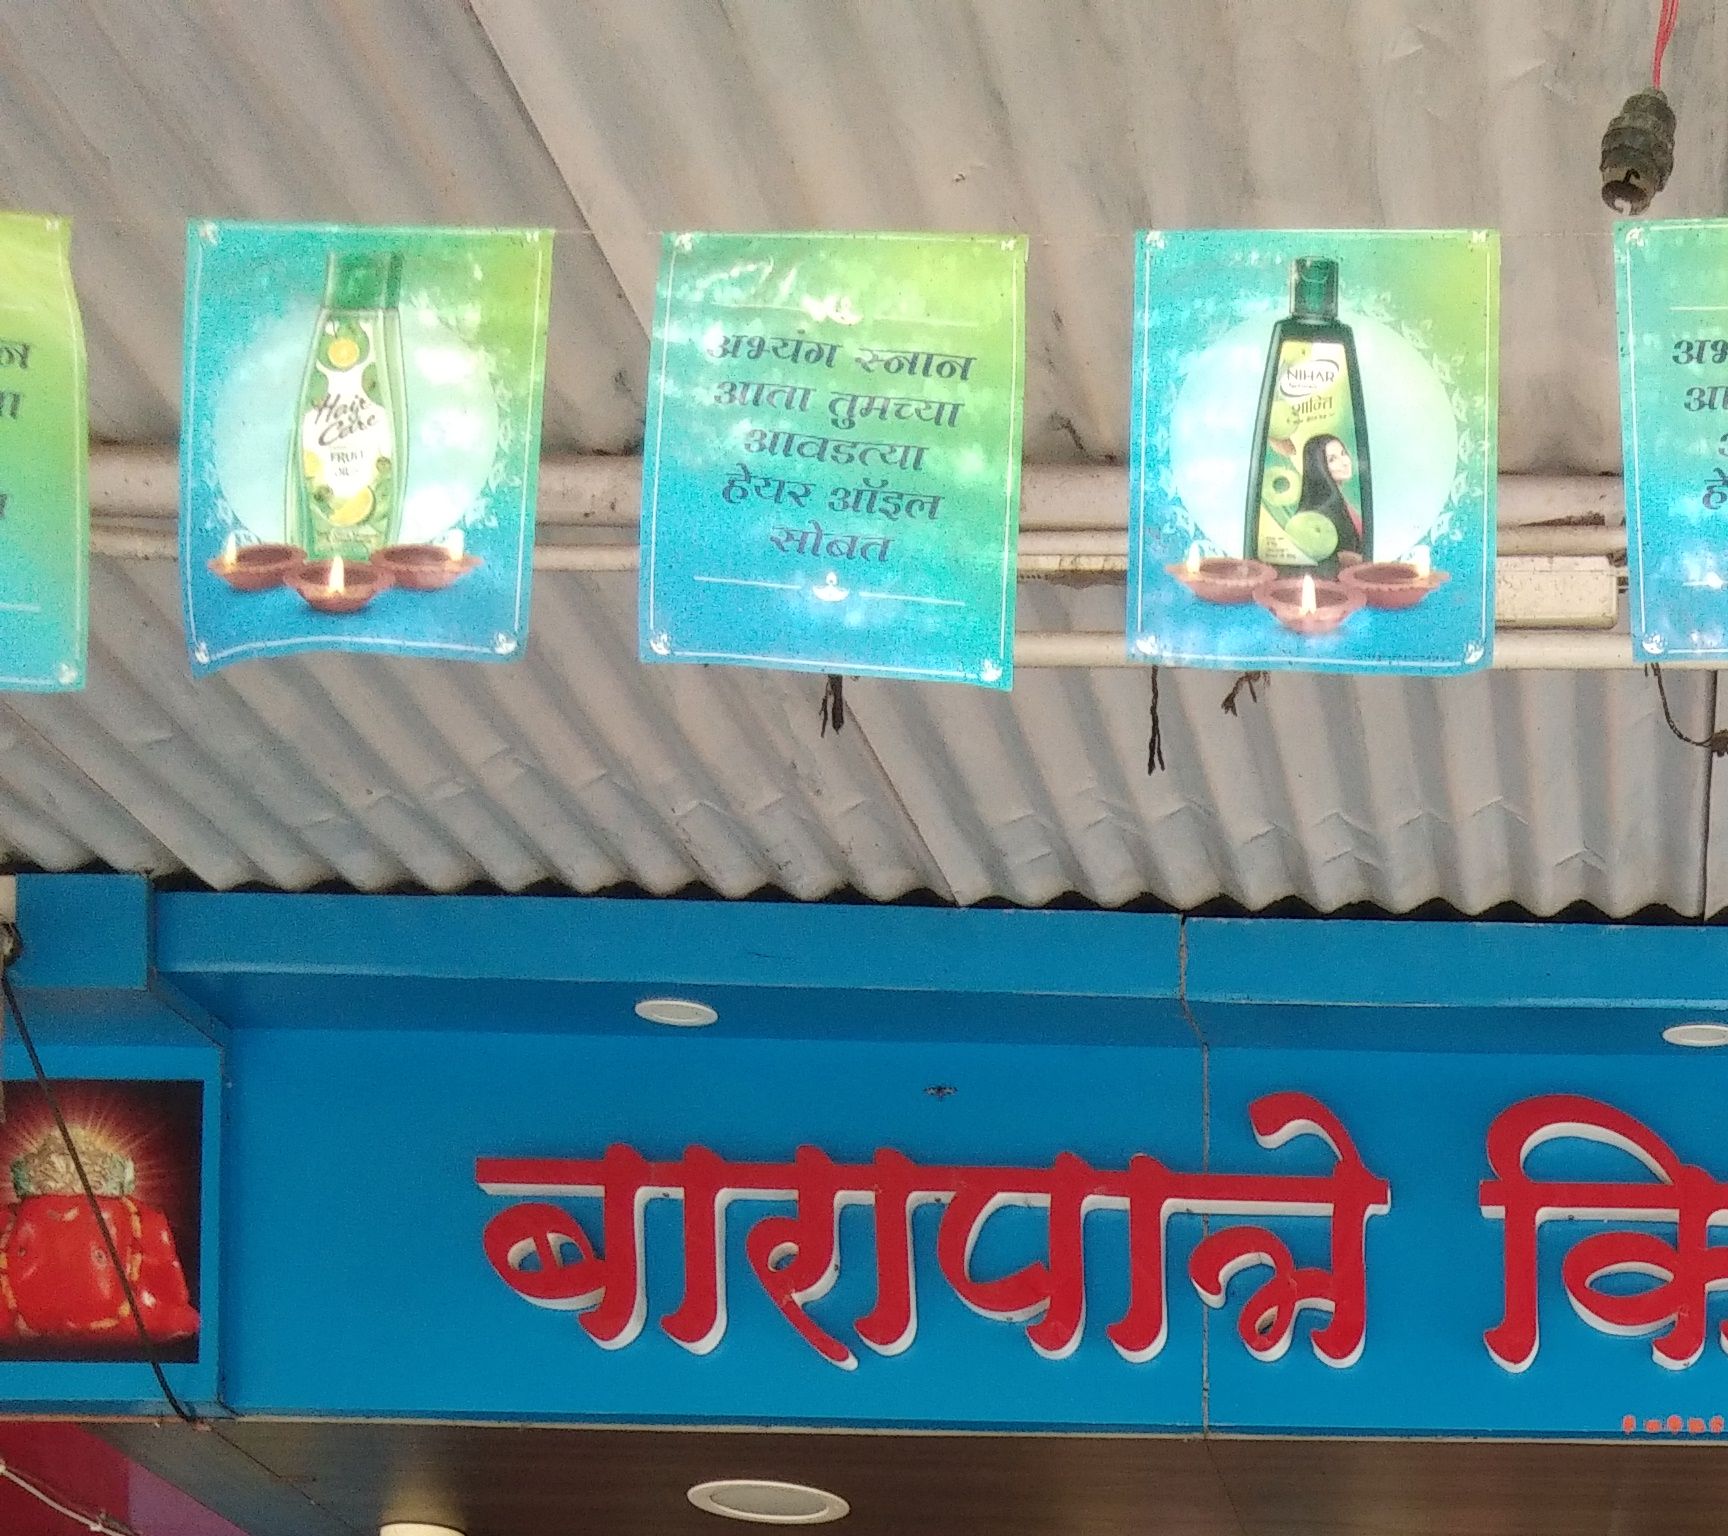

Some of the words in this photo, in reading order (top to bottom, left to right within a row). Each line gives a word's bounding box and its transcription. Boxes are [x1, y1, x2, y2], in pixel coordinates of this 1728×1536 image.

[706, 329, 844, 368] अभ्यंग
[855, 347, 978, 381] स्नान
[1286, 368, 1335, 384] NIHAR
[714, 381, 816, 411] आता
[829, 391, 965, 429] तुमच्या
[744, 429, 930, 471] आवडत्या
[722, 463, 816, 508] हेयर
[828, 477, 945, 521] ऑइल
[770, 520, 895, 562] सोबत
